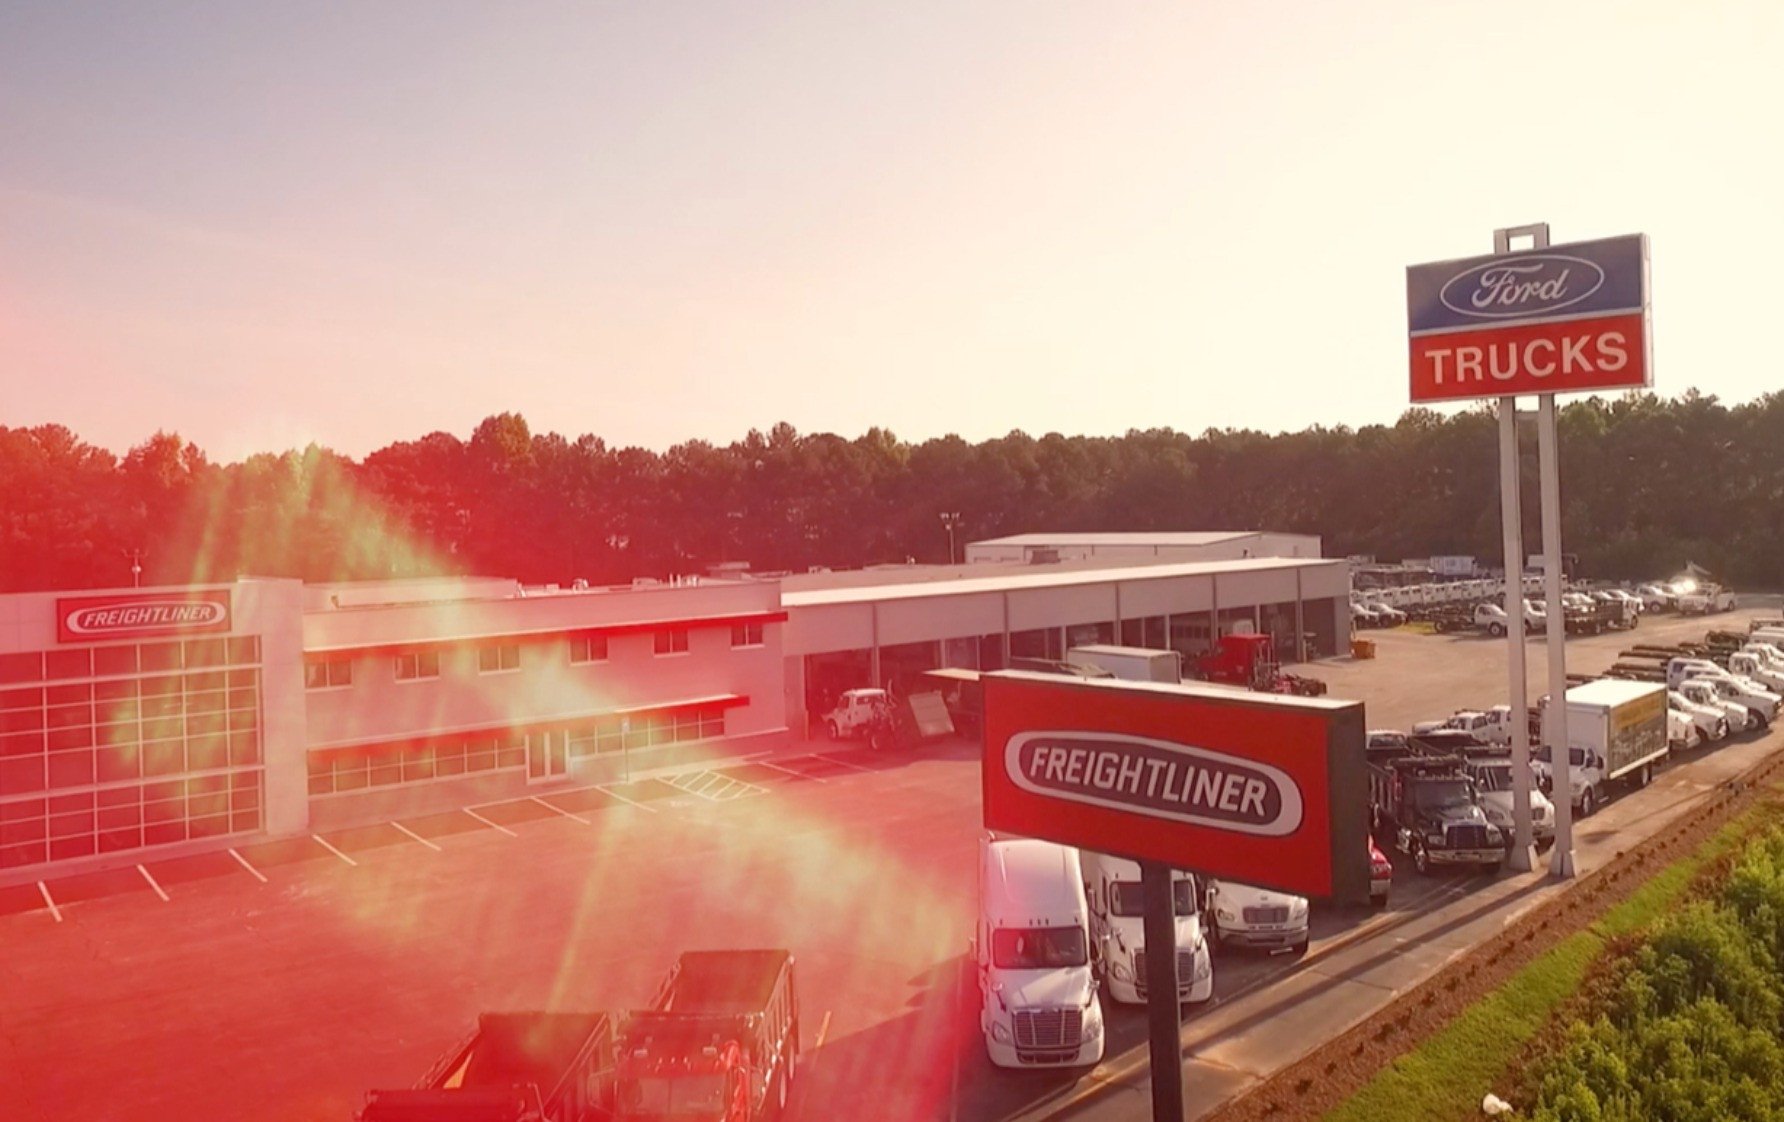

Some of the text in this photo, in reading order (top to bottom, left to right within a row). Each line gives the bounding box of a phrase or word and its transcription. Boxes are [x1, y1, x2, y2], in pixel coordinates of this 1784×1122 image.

[1471, 263, 1569, 307] Ford
[1424, 331, 1628, 384] TRUCKS
[83, 606, 212, 627] FREIGHTLINER
[1030, 747, 1267, 817] FREIGHTLINER
